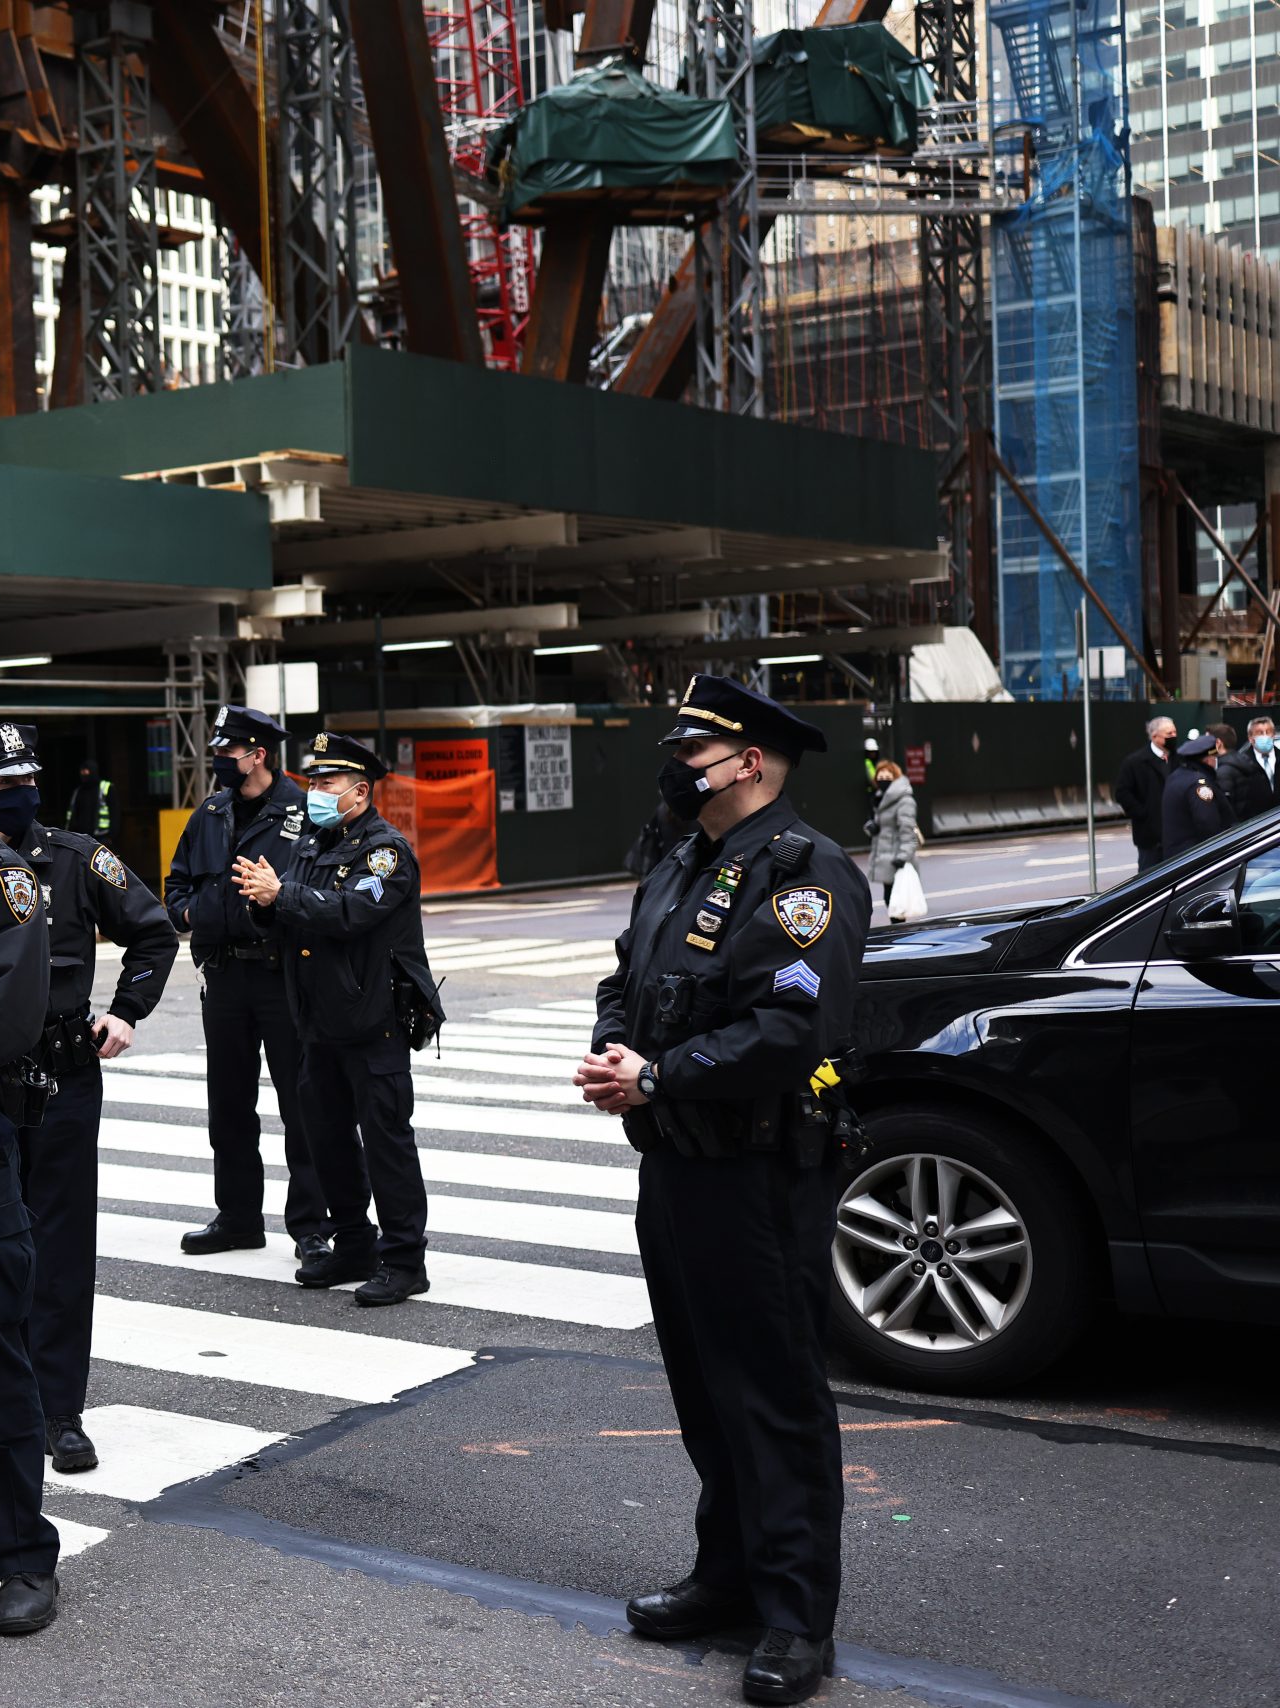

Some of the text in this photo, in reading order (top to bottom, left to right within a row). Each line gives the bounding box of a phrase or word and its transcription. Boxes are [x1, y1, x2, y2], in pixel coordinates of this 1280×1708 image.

[457, 750, 483, 761] CLOSED
[8, 870, 27, 878] POLICE
[788, 890, 818, 898] POLICE
[778, 896, 828, 907] DEPARTMENT
[779, 911, 799, 936] CITY OF
[807, 910, 829, 939] NEW YORK
